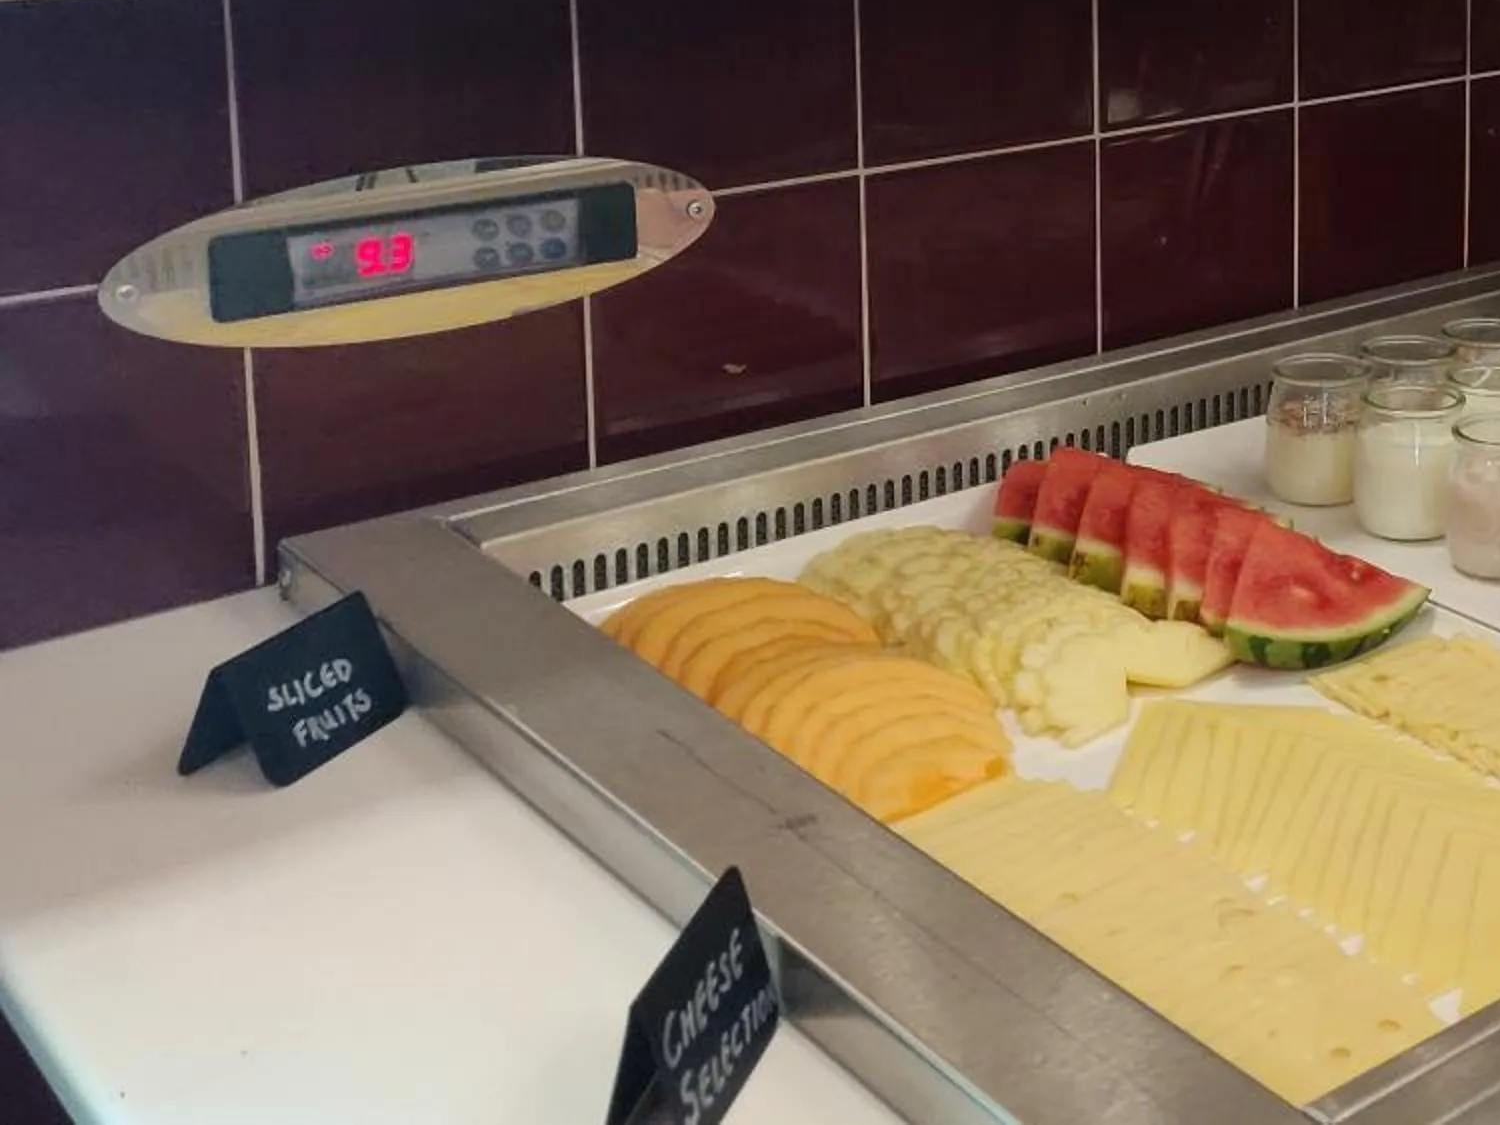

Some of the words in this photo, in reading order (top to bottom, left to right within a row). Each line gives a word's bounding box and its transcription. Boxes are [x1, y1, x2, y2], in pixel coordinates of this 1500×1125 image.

[266, 658, 353, 713] SLICED
[292, 688, 372, 747] FRUITS
[662, 927, 744, 1070] CHEESE
